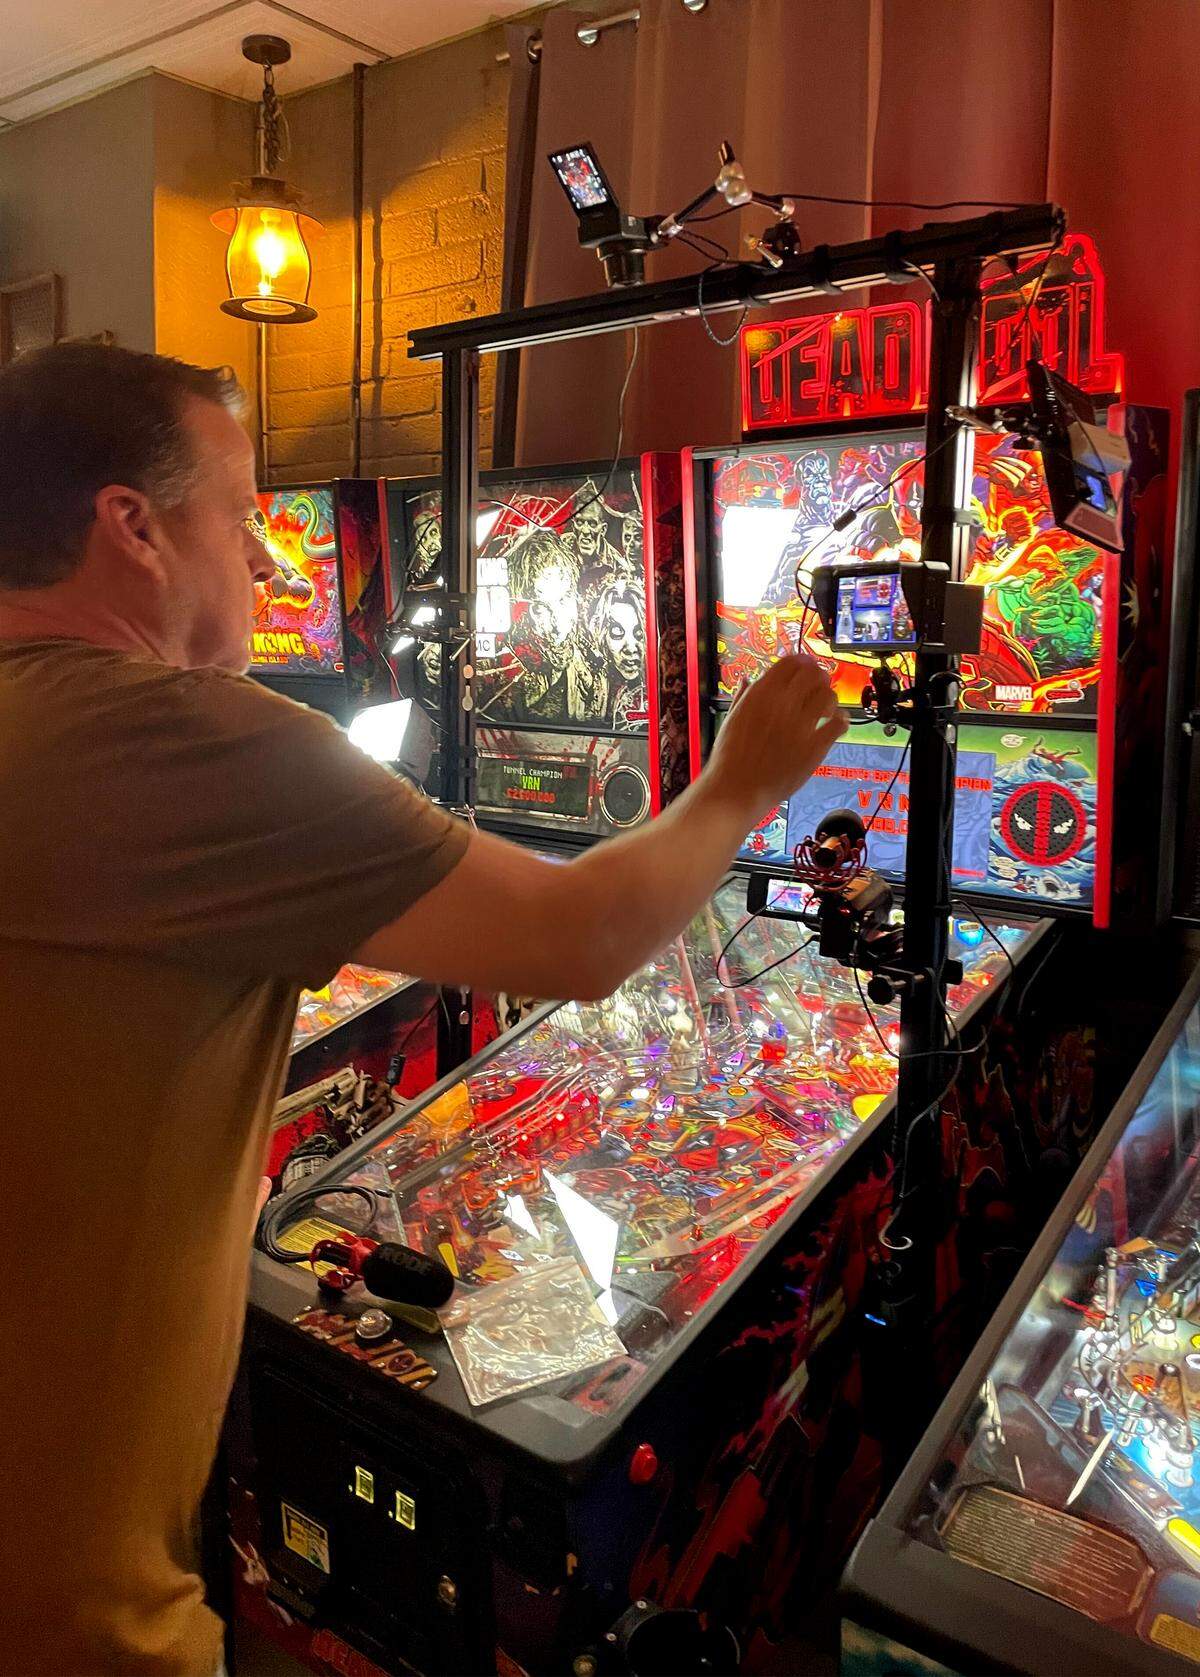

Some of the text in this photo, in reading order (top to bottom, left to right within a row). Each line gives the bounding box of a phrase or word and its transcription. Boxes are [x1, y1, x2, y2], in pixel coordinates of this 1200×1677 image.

[253, 632, 305, 655] KONG
[995, 685, 1033, 701] MARVEL
[503, 765, 563, 779] TUNNEL CHAMPION
[522, 776, 541, 791] VRN
